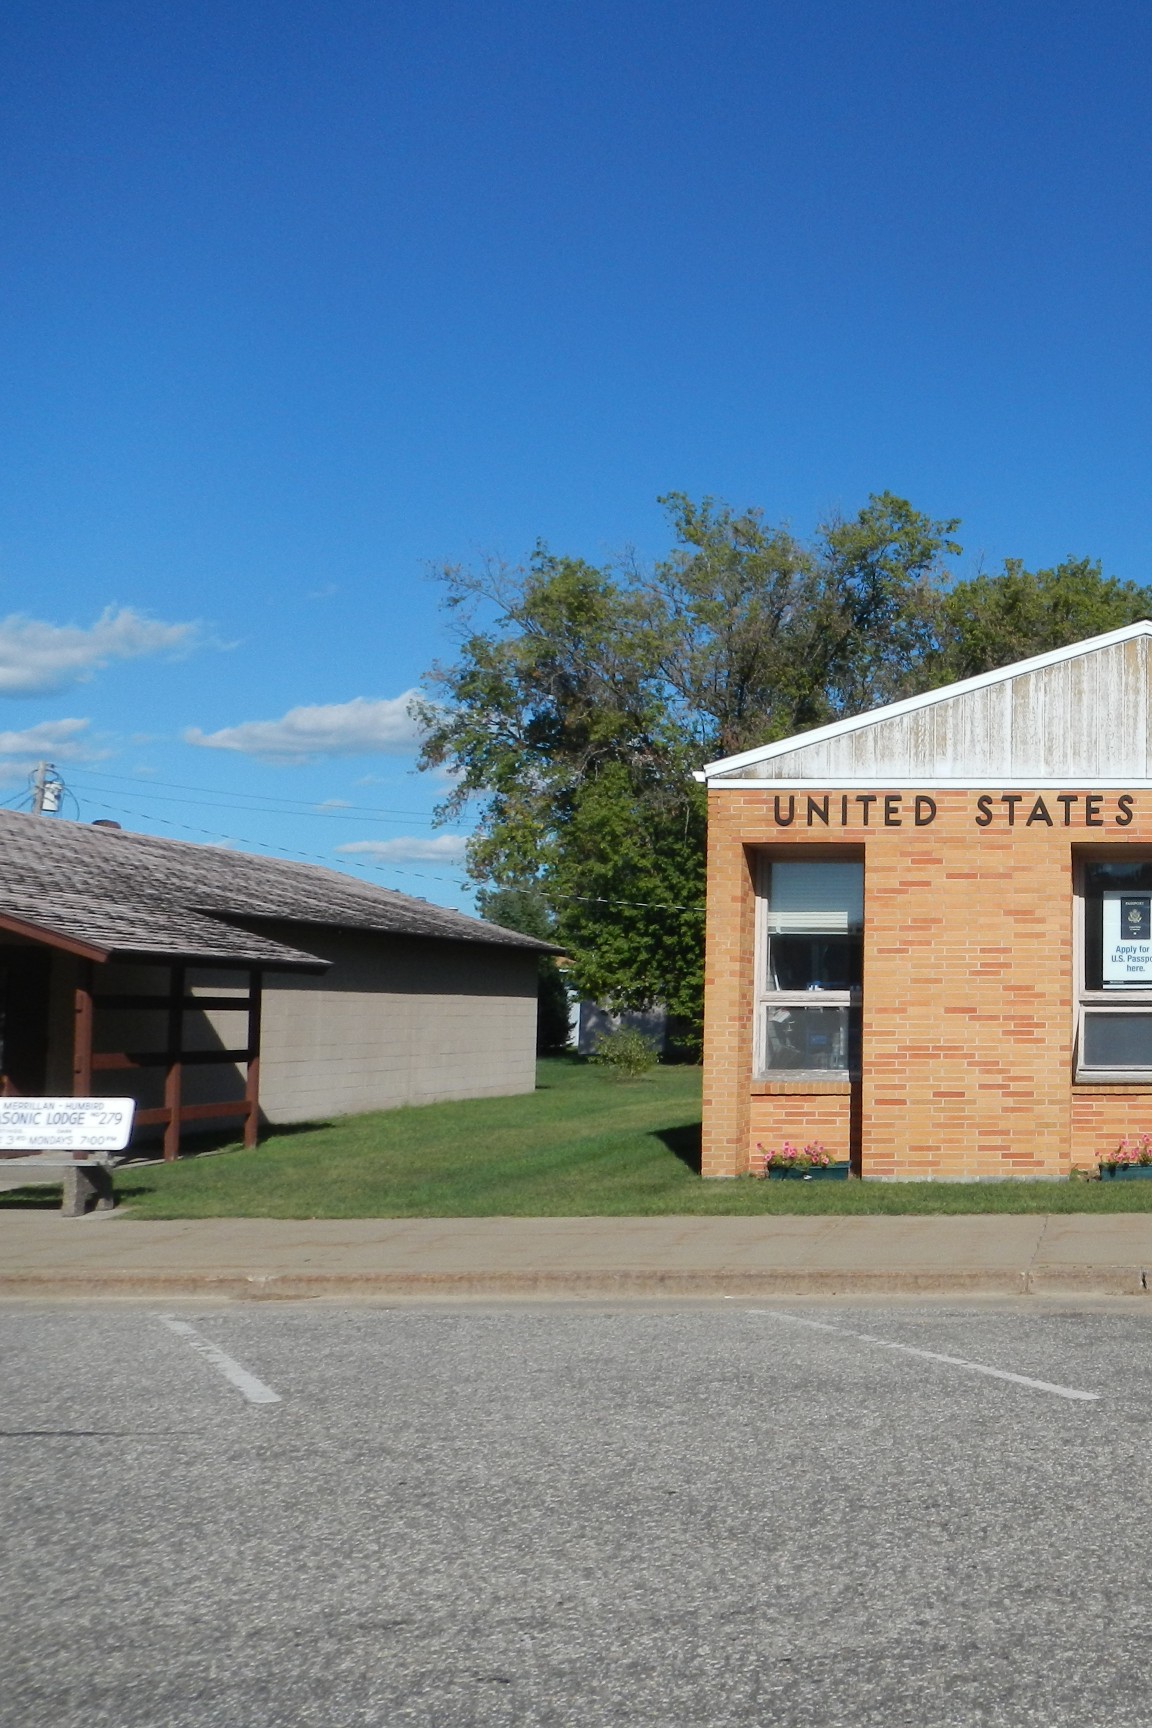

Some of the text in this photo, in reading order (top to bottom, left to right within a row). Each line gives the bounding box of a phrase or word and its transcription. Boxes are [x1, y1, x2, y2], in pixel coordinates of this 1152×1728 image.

[773, 795, 937, 827] UNITED
[975, 795, 1134, 827] STATES
[1115, 945, 1137, 955] Apply
[1139, 945, 1150, 953] for
[1126, 964, 1146, 972] here.
[3, 1102, 55, 1111] MERRILLAN
[65, 1102, 104, 1111] HUMBIRD
[46, 1111, 86, 1125] LODGE
[29, 1136, 74, 1145] MONDAYS
